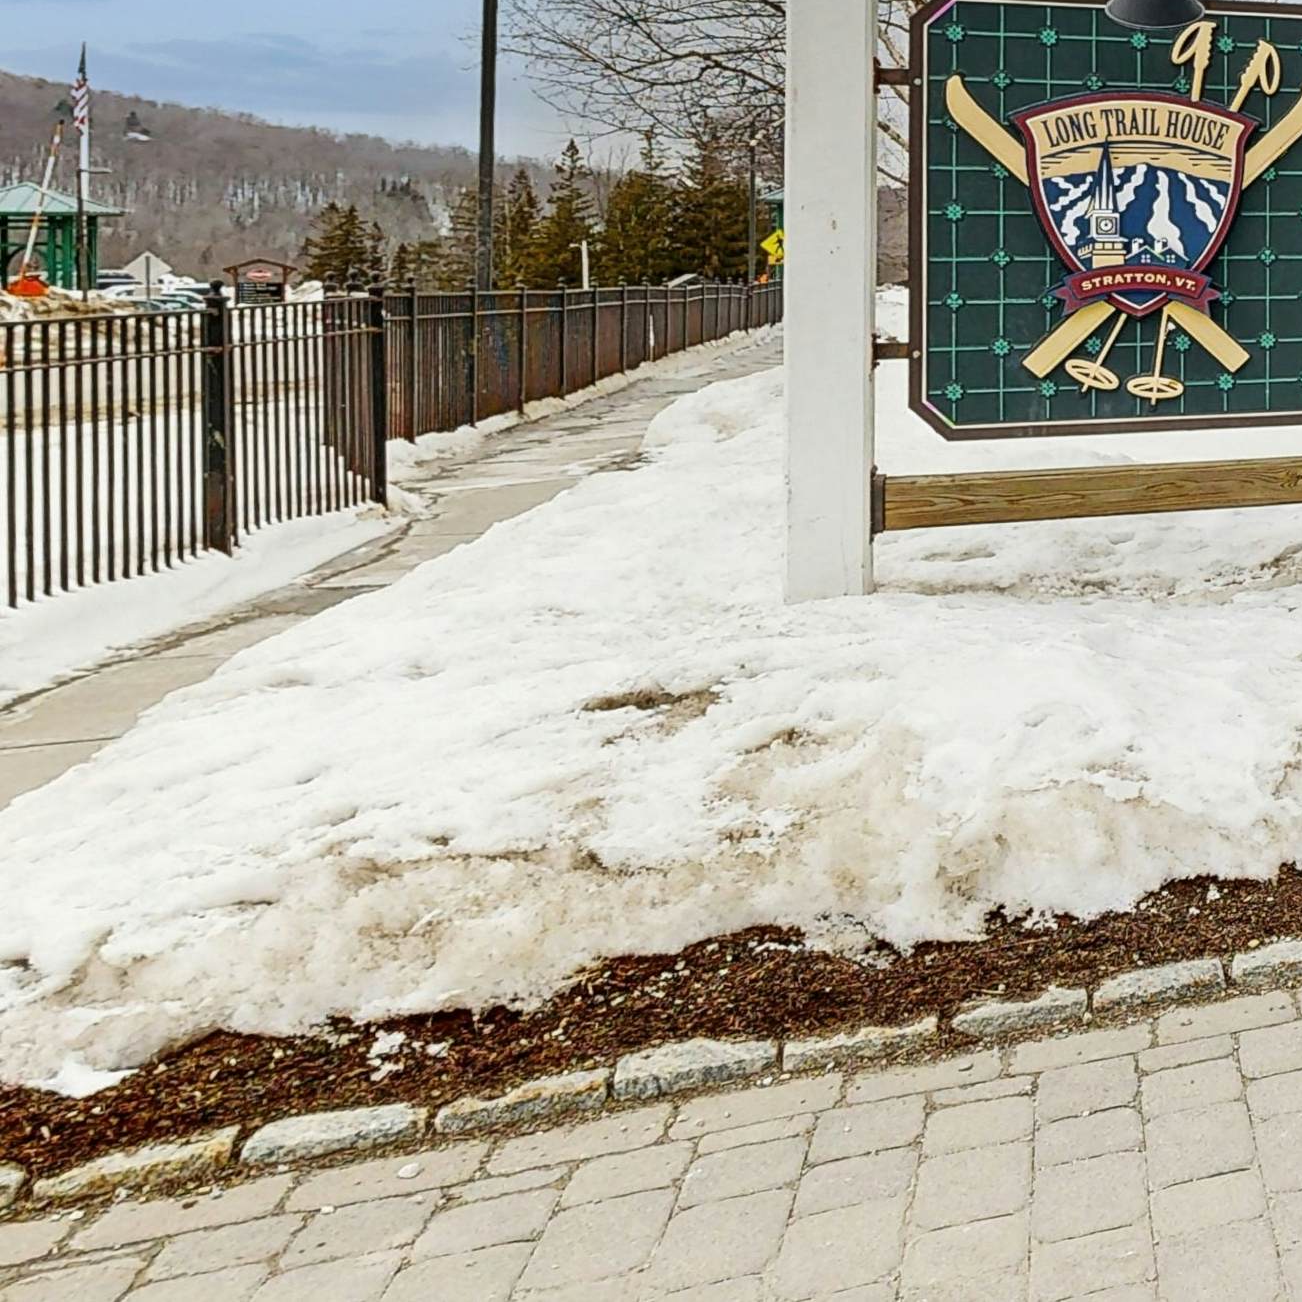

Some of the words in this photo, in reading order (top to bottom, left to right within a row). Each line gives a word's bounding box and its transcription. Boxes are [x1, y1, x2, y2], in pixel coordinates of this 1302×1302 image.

[1040, 111, 1099, 148] LONG
[1101, 107, 1160, 138] TRAIL
[1165, 109, 1230, 150] HOUSE
[1081, 273, 1171, 291] STRATTON,
[1175, 276, 1196, 291] VT.
